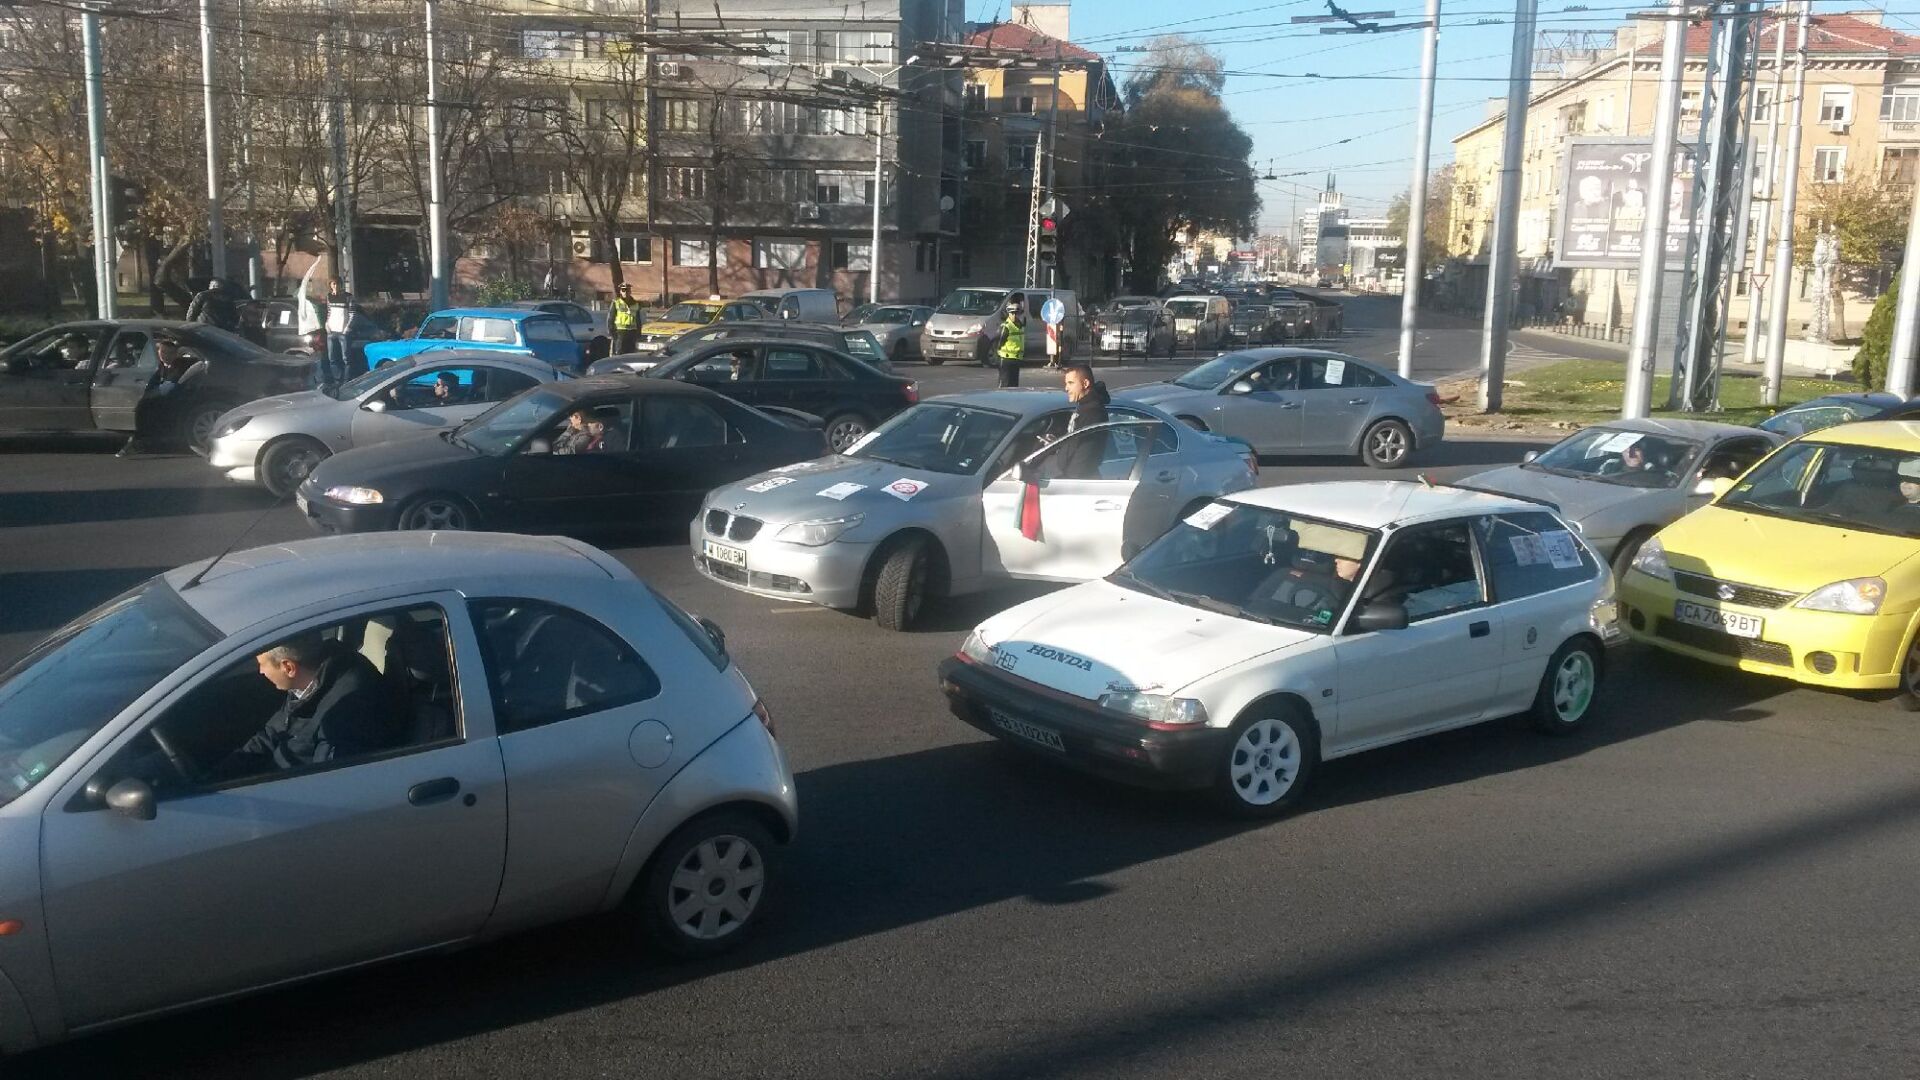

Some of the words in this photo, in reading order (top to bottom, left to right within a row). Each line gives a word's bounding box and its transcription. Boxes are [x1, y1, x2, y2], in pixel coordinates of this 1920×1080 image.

[1684, 605, 1701, 619] CA
[1702, 609, 1737, 627] 7069
[1739, 616, 1759, 632] BT
[1026, 644, 1093, 671] HONDA
